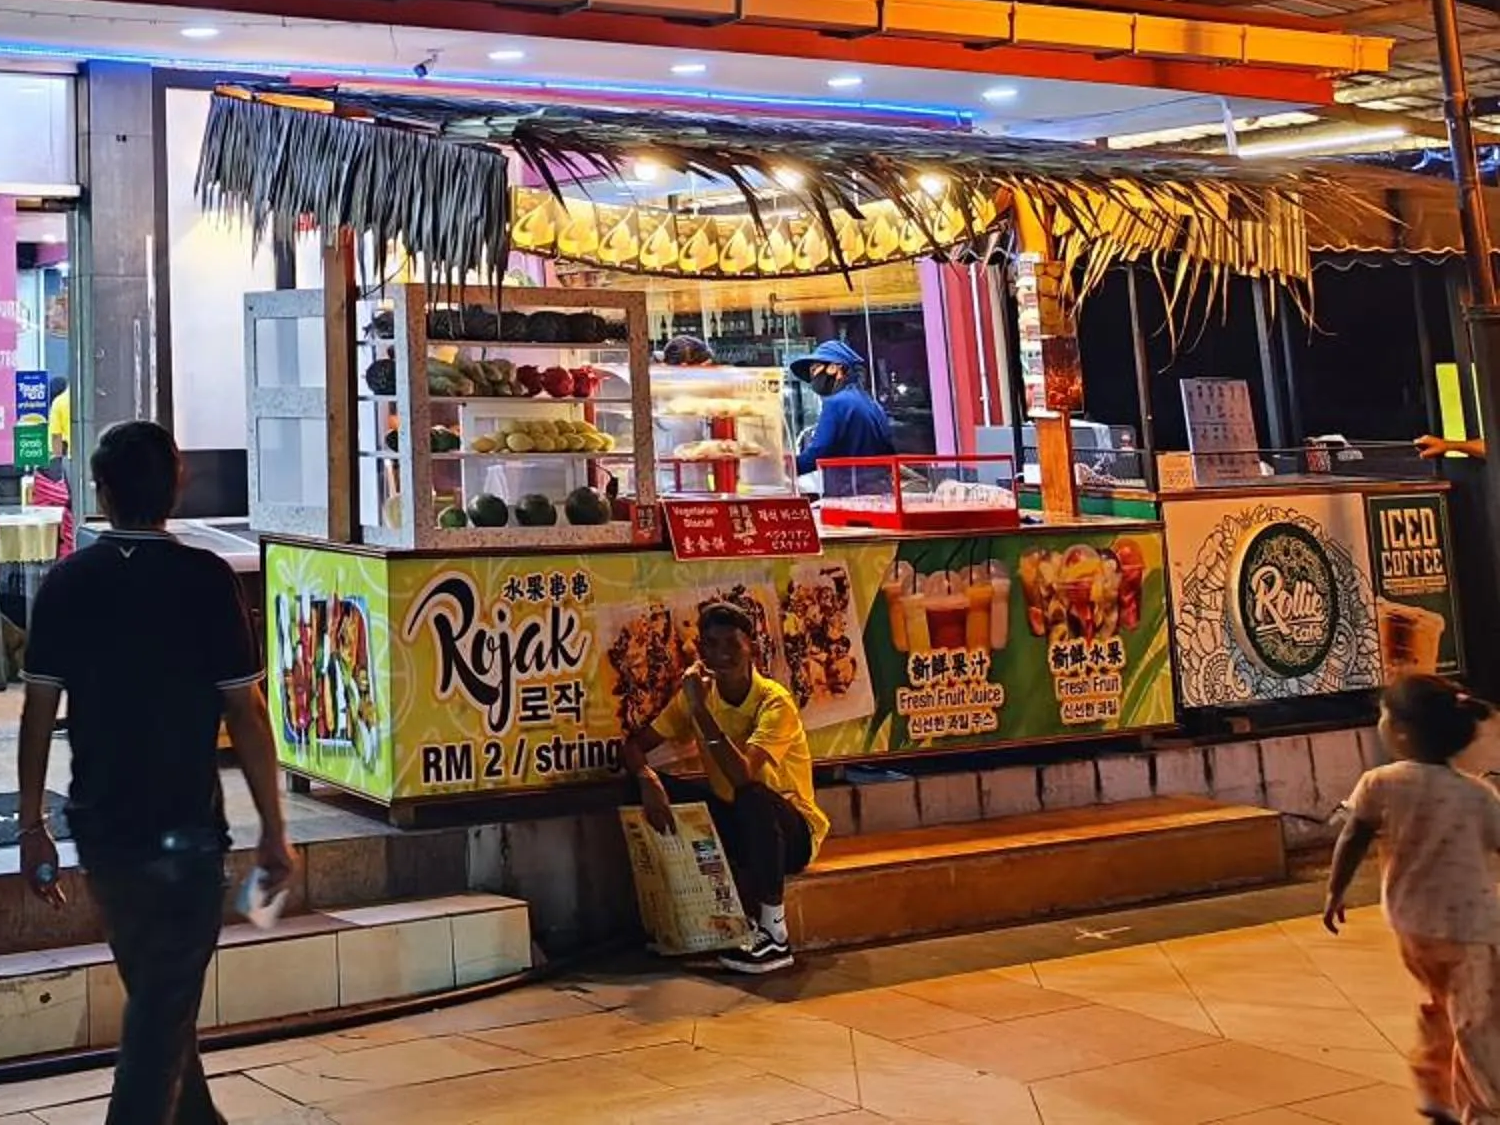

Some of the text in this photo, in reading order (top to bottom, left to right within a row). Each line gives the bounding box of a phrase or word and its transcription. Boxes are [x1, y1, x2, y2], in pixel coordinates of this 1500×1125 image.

[1379, 507, 1438, 549] ICED
[1381, 548, 1444, 577] COFFEE
[503, 571, 593, 602] 水果串串
[1252, 565, 1324, 634] Rollie
[408, 577, 588, 733] Rojak
[518, 682, 586, 724] 로작
[899, 687, 1001, 709] Fresh Fruit Juice
[1058, 676, 1119, 695] Fresh Fruit
[422, 735, 622, 783] RM 2 / string
